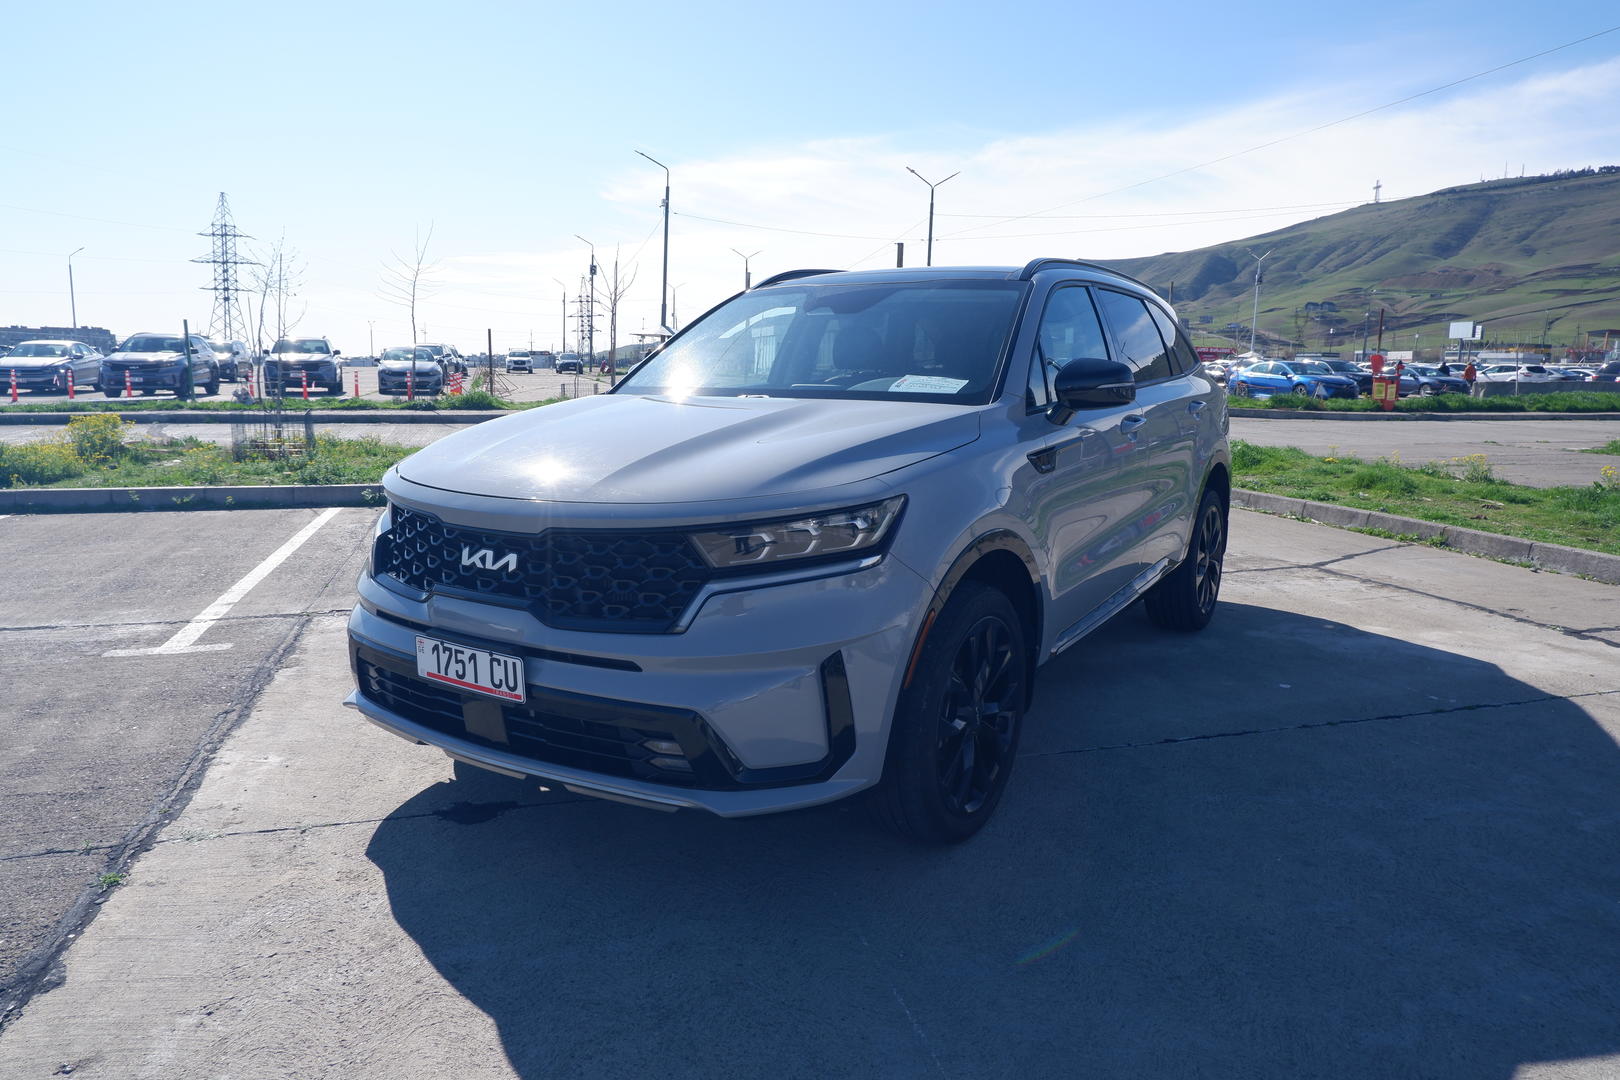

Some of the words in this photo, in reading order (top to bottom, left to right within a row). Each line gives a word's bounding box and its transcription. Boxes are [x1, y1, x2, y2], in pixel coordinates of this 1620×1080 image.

[461, 545, 518, 572] KIA
[432, 643, 478, 684] 1751
[489, 657, 518, 692] CU
